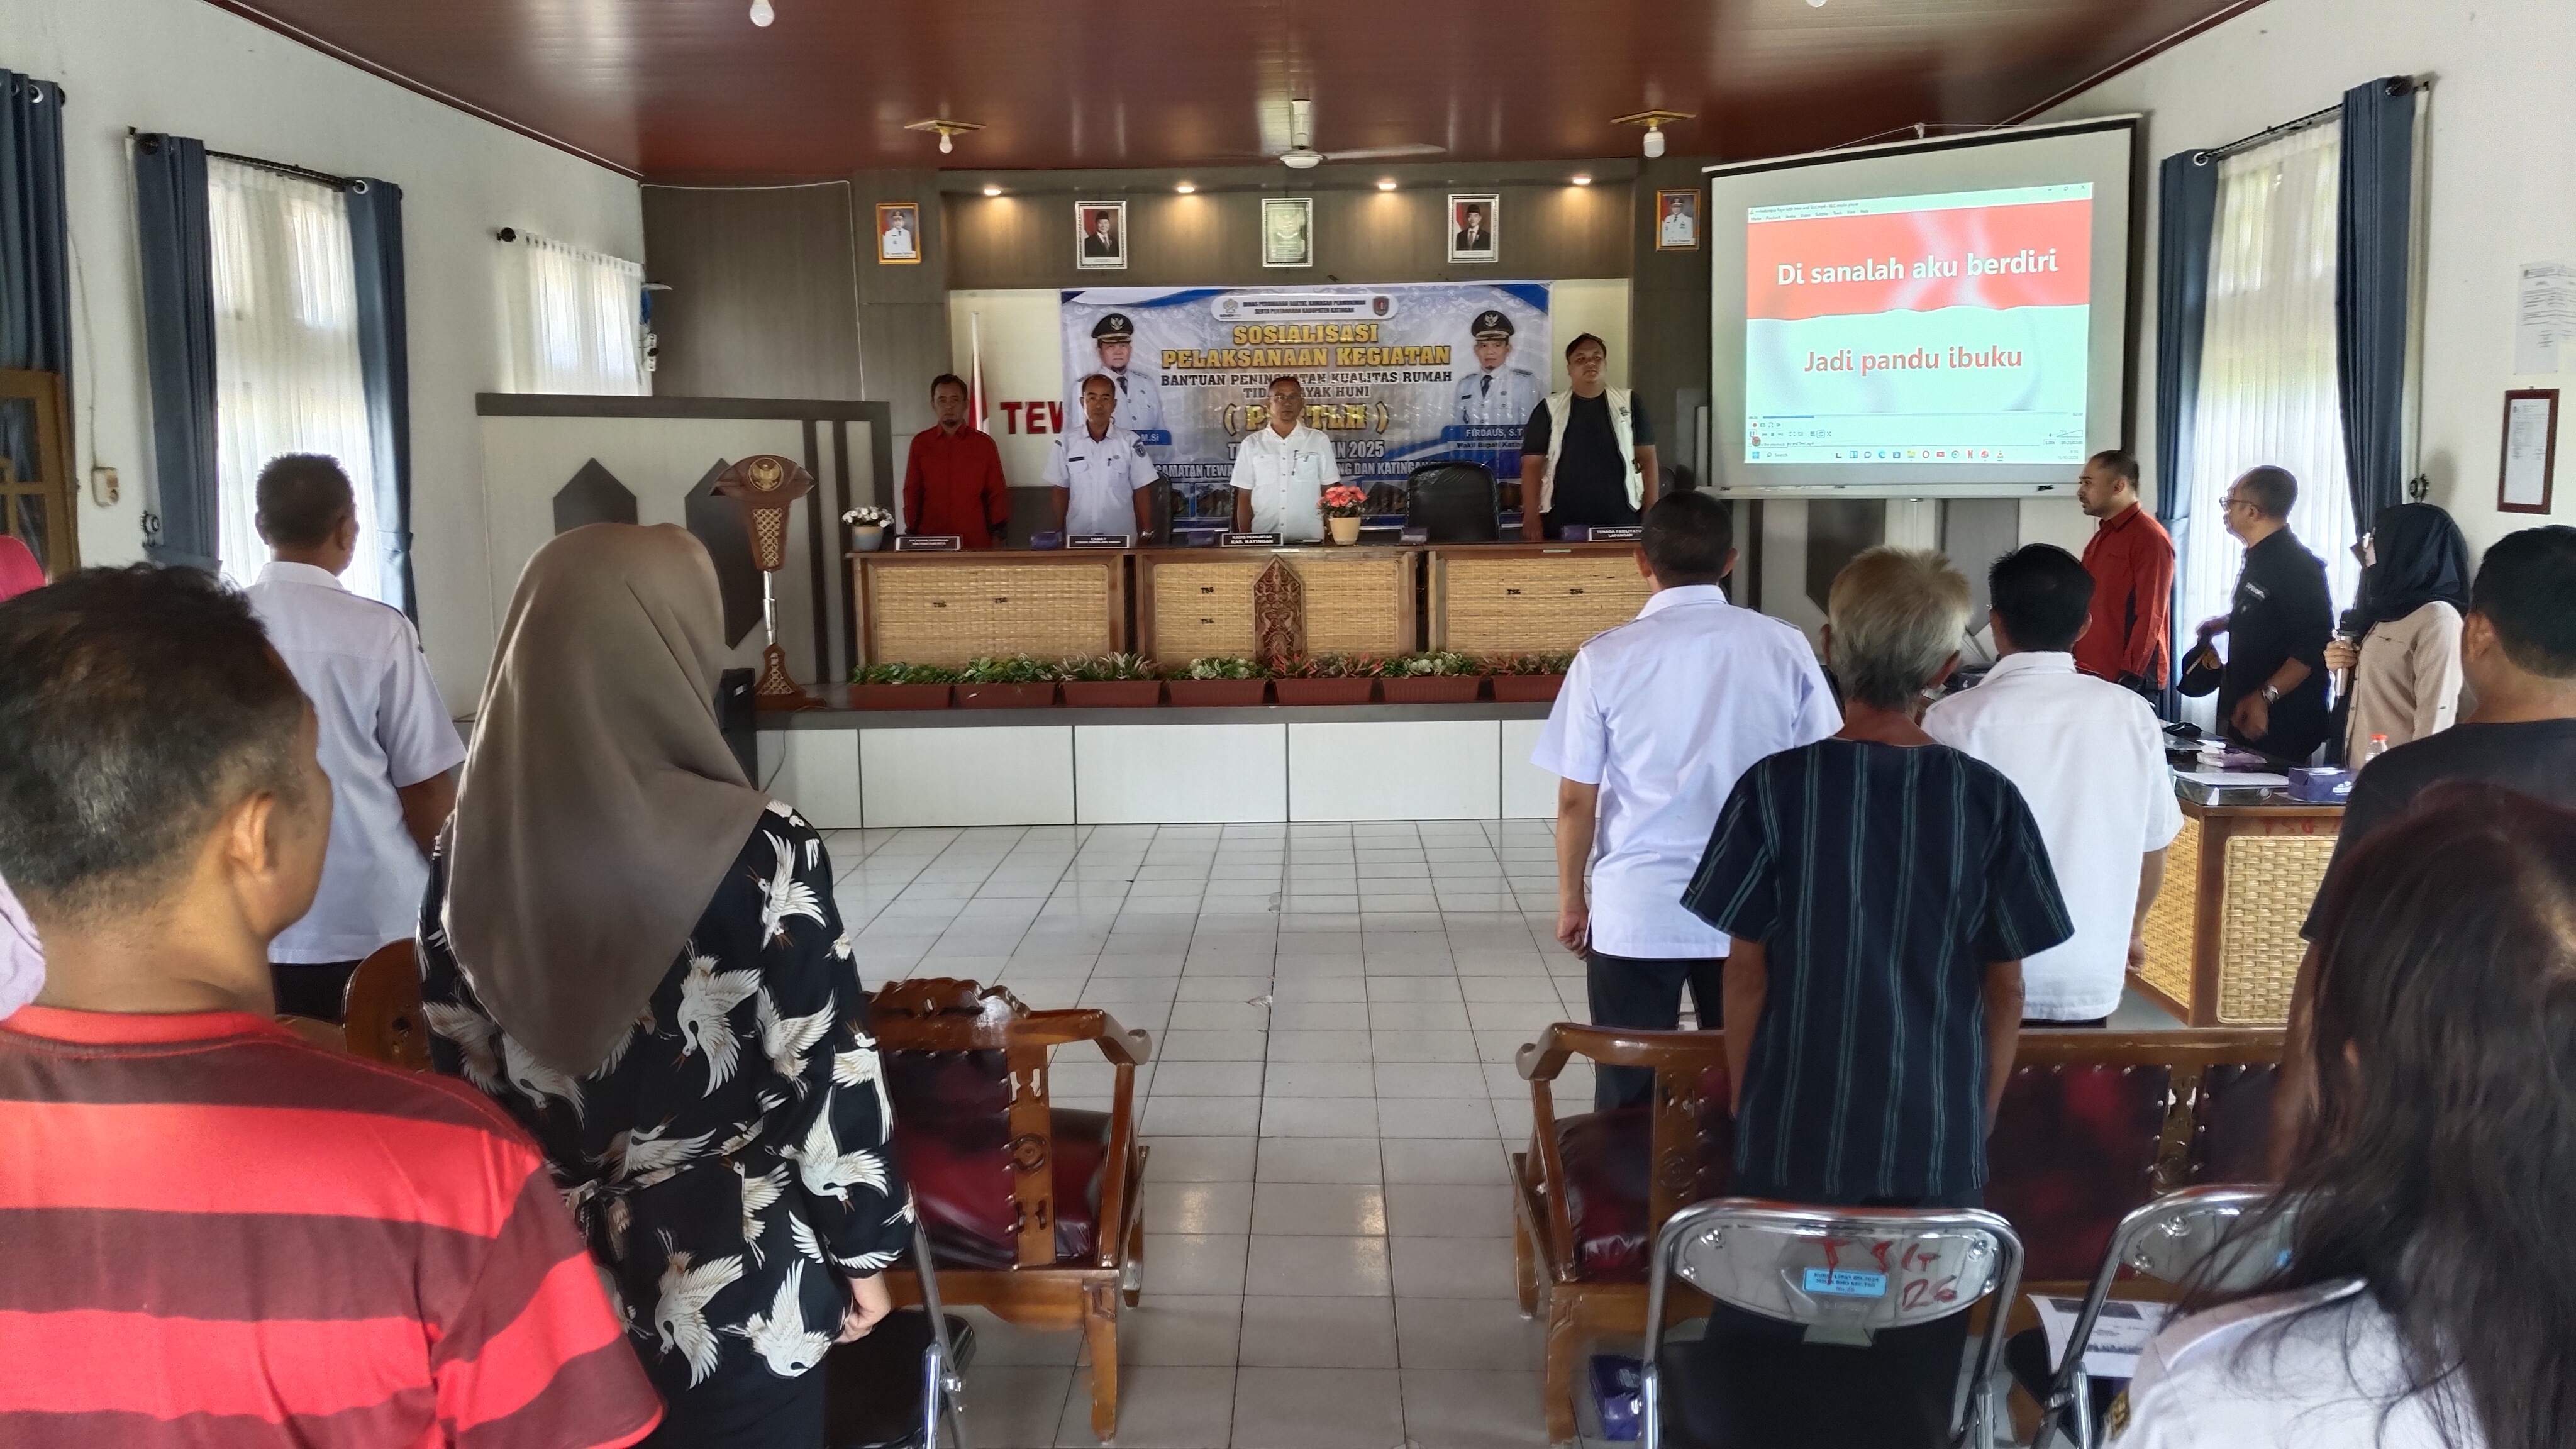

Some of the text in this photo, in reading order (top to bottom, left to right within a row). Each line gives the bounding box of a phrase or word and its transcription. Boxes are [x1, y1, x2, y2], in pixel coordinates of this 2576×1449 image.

[1777, 248, 2059, 286] Di sanalah aku berdiri
[1233, 323, 1379, 344] SOSIALISASI
[1162, 346, 1451, 369] PELAKSANAAN KEGIATAN
[1804, 345, 2023, 377] Jadi pandu ibuku
[1161, 374, 1226, 386] BANTUAN
[1331, 372, 1398, 383] KUALITAS
[1402, 371, 1452, 382] RUMAH
[1336, 386, 1370, 397] HUNI
[1466, 428, 1507, 438] FIRDAUS,
[1348, 441, 1384, 458] 2025
[1354, 462, 1375, 475] DAN
